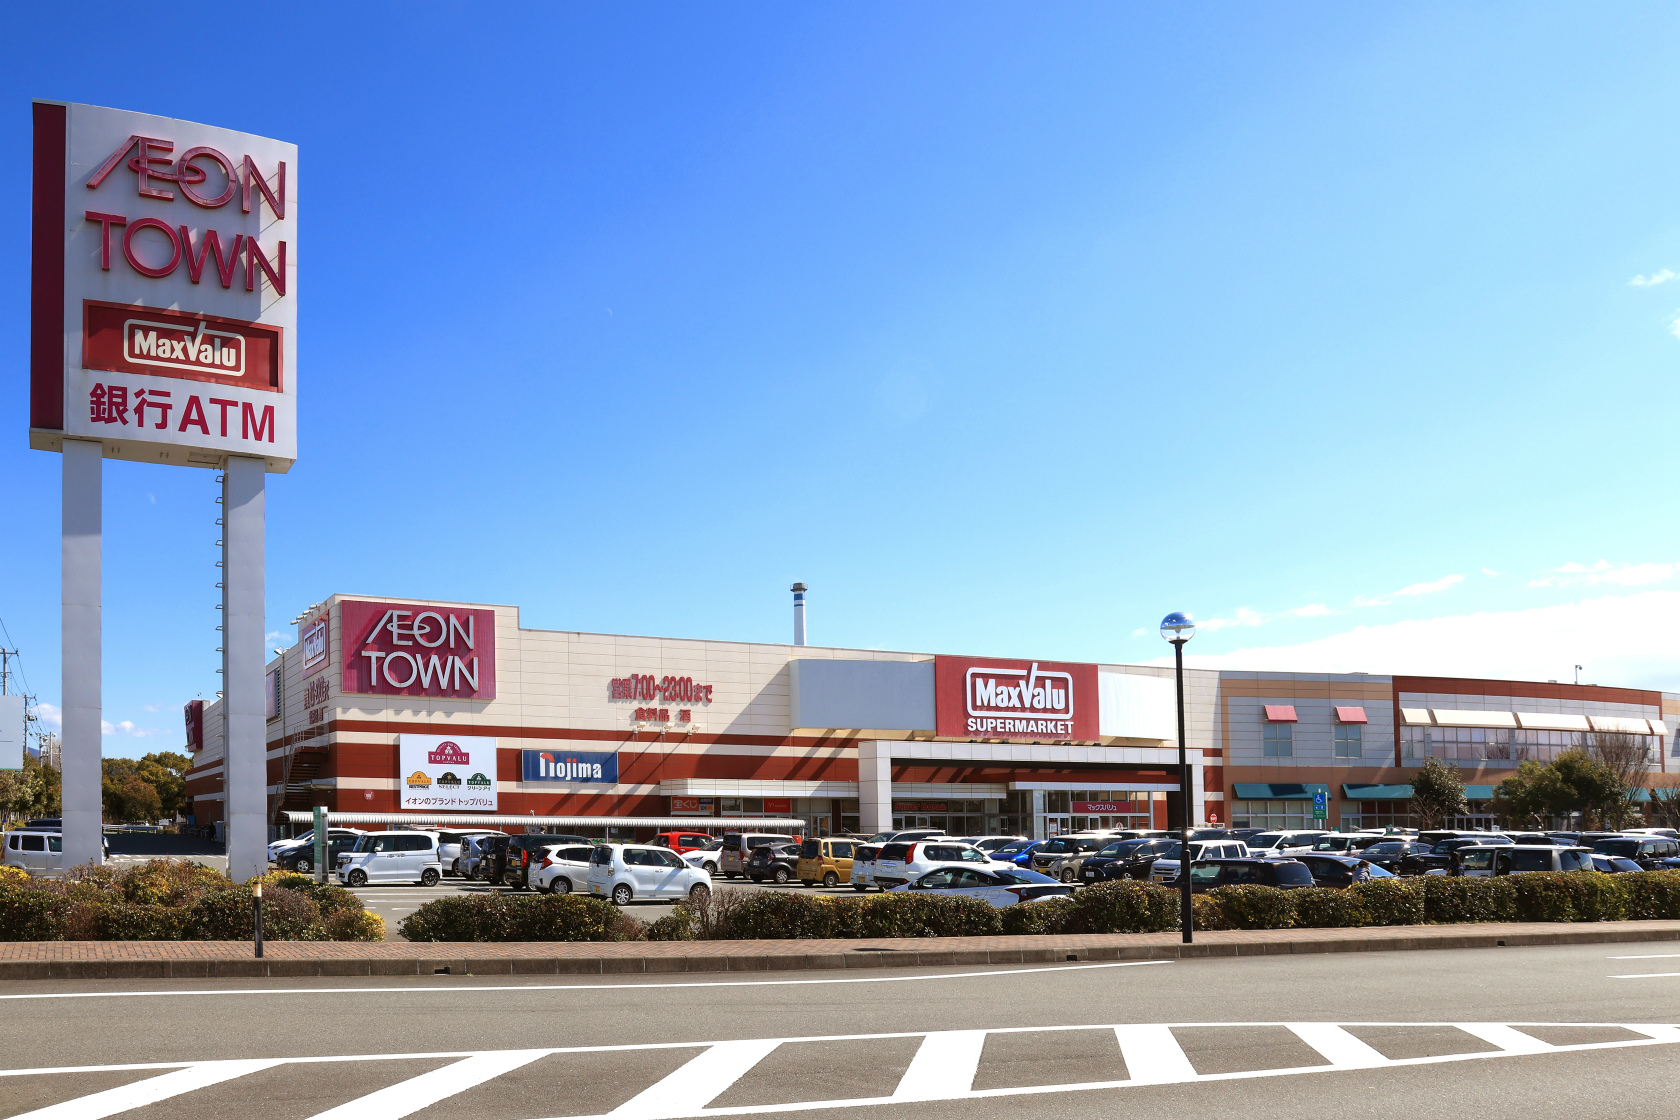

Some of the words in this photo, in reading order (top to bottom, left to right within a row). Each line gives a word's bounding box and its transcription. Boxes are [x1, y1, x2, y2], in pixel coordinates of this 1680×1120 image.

[85, 210, 286, 296] TOWN
[134, 320, 236, 367] MaxValu
[89, 382, 275, 443] 銀行ATM
[361, 650, 479, 692] TOWN
[975, 662, 1066, 710] MaxValu
[634, 706, 670, 722] 食料品
[679, 708, 692, 723] 酒
[967, 717, 1075, 734] SUPERMARKET
[431, 754, 467, 762] TOPVALU
[405, 797, 457, 805] イオンのブランド
[458, 798, 493, 806] トップバリュ
[673, 799, 698, 809] 宝くじ
